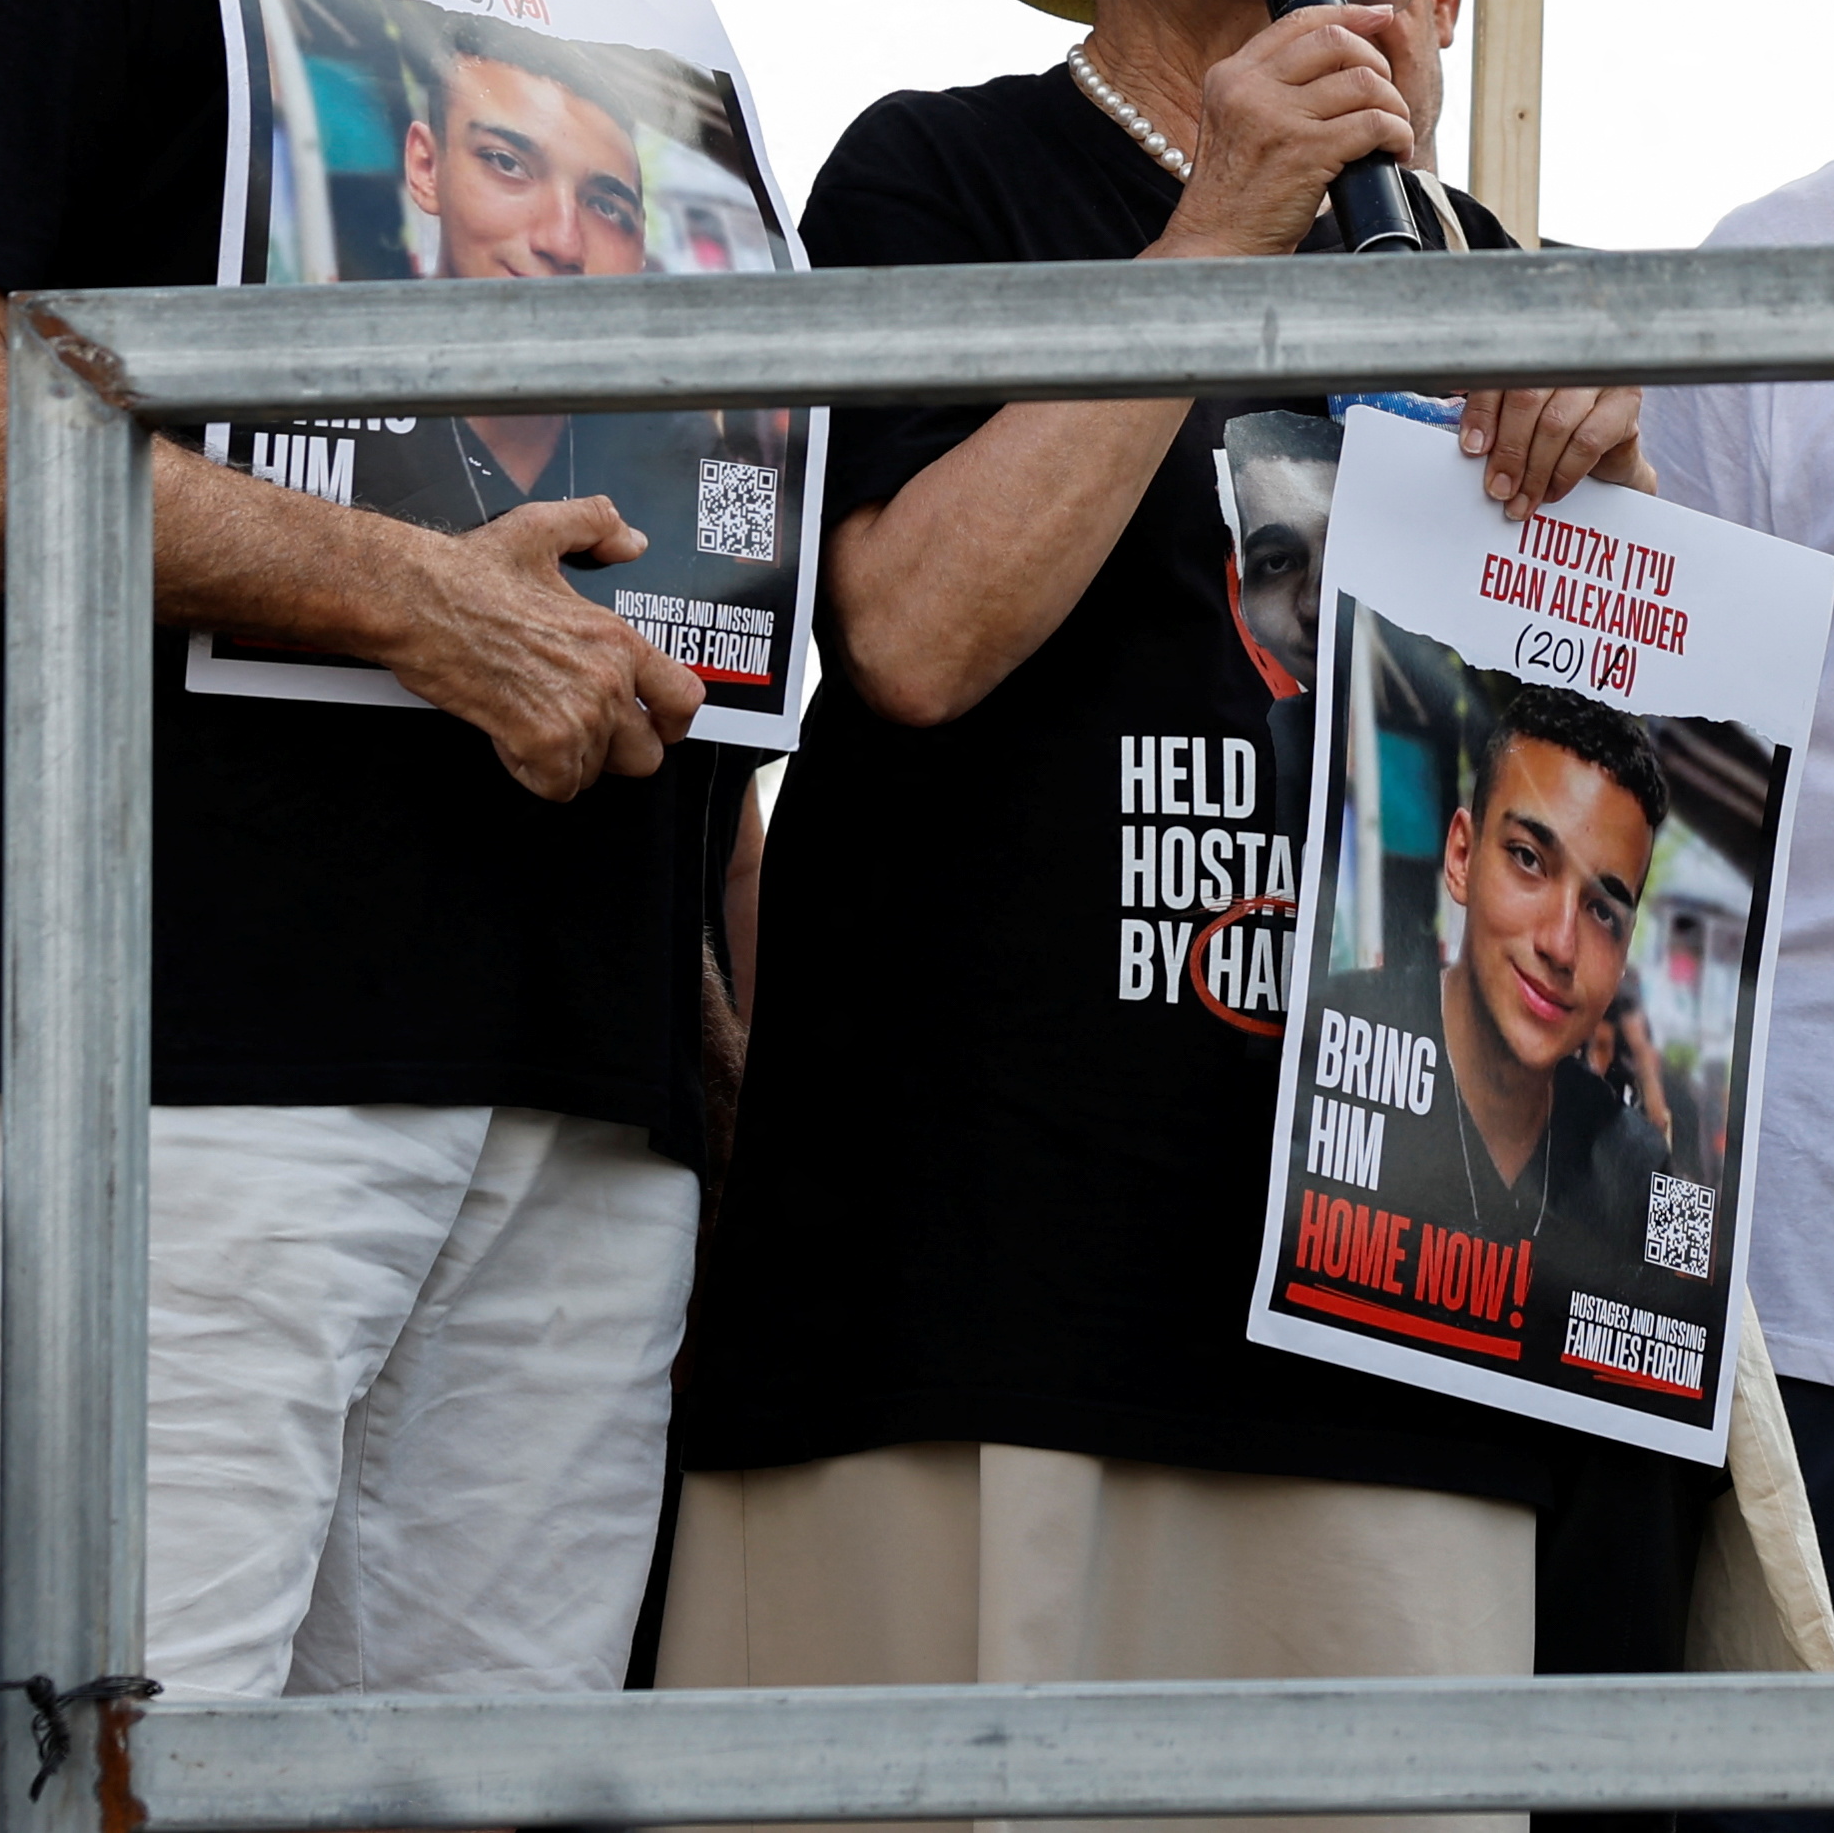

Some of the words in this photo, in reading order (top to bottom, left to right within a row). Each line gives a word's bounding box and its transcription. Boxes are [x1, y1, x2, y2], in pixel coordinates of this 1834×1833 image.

[252, 432, 355, 507] HIM
[1480, 553, 1547, 612] EDAN
[1548, 575, 1688, 656] ALEXANDER
[1622, 542, 1676, 597] עידן
[615, 589, 685, 624] HOSTAGES
[686, 600, 714, 628] AND
[716, 603, 774, 637] MISSING
[702, 630, 771, 676] FORUM
[1515, 623, 1584, 683] (20)
[1121, 736, 1257, 819] HELD
[1121, 826, 1304, 918] HOSTA
[1119, 919, 1193, 1004] BY
[1315, 1008, 1437, 1115] BRING
[1306, 1095, 1385, 1191] HIM
[1296, 1189, 1411, 1295] HOME
[1414, 1222, 1533, 1329] NOW!
[1564, 1317, 1642, 1373] FAMILIES
[1642, 1339, 1704, 1390] FORUM
[1569, 1290, 1629, 1331] HOSTAGES
[1629, 1308, 1655, 1338] AND
[1655, 1315, 1707, 1352] MISSING
